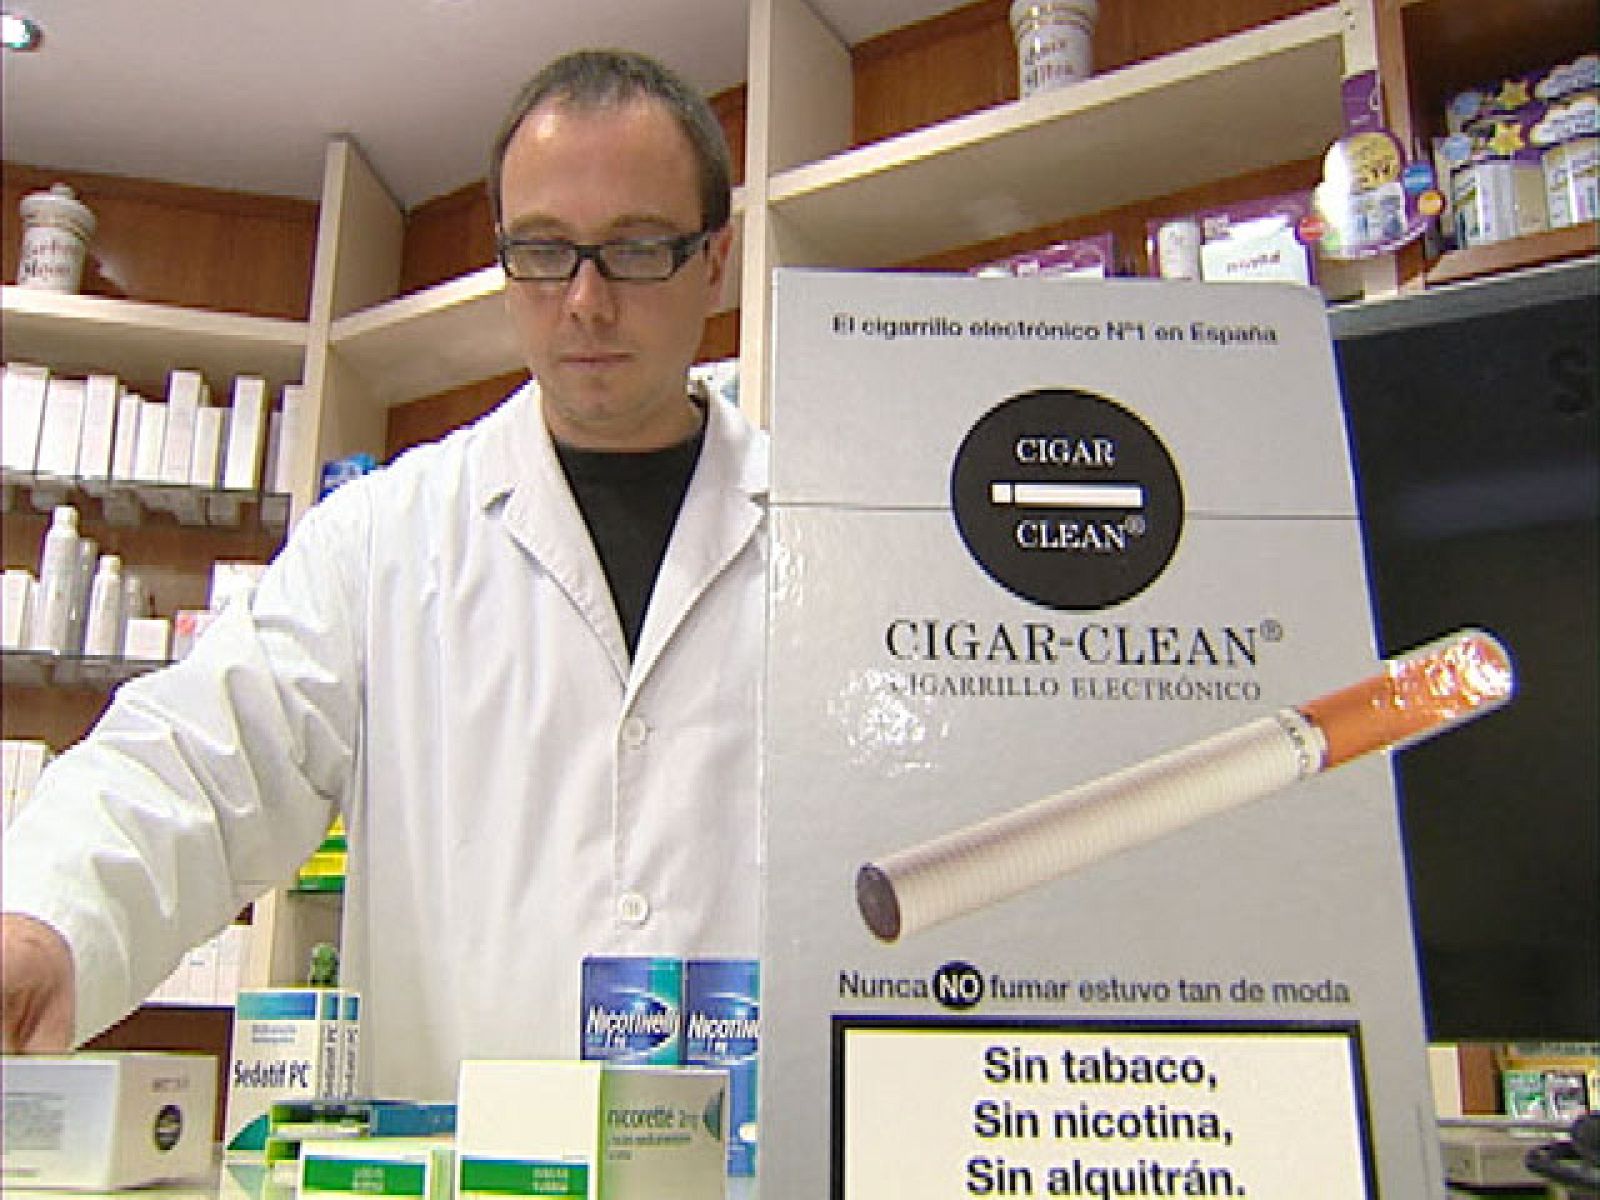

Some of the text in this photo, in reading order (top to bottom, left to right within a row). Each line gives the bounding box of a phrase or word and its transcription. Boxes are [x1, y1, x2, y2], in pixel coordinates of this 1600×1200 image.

[832, 315, 855, 335] El
[862, 315, 961, 341] cigarrillo
[969, 319, 1100, 341] electrónico
[1154, 326, 1184, 342] en
[1190, 321, 1278, 346] España
[1015, 437, 1115, 468] CIGAR
[1071, 676, 1262, 701] ELECTRÓNICO
[838, 968, 1351, 1004] Nunca NO fumar estuvo tan de moda
[234, 1059, 309, 1090] Sedatif PC
[984, 1045, 1219, 1093] Sin tabaco,
[974, 1099, 1234, 1147] Sin nicotina,
[966, 1156, 1246, 1200] Sin alquitrán.
